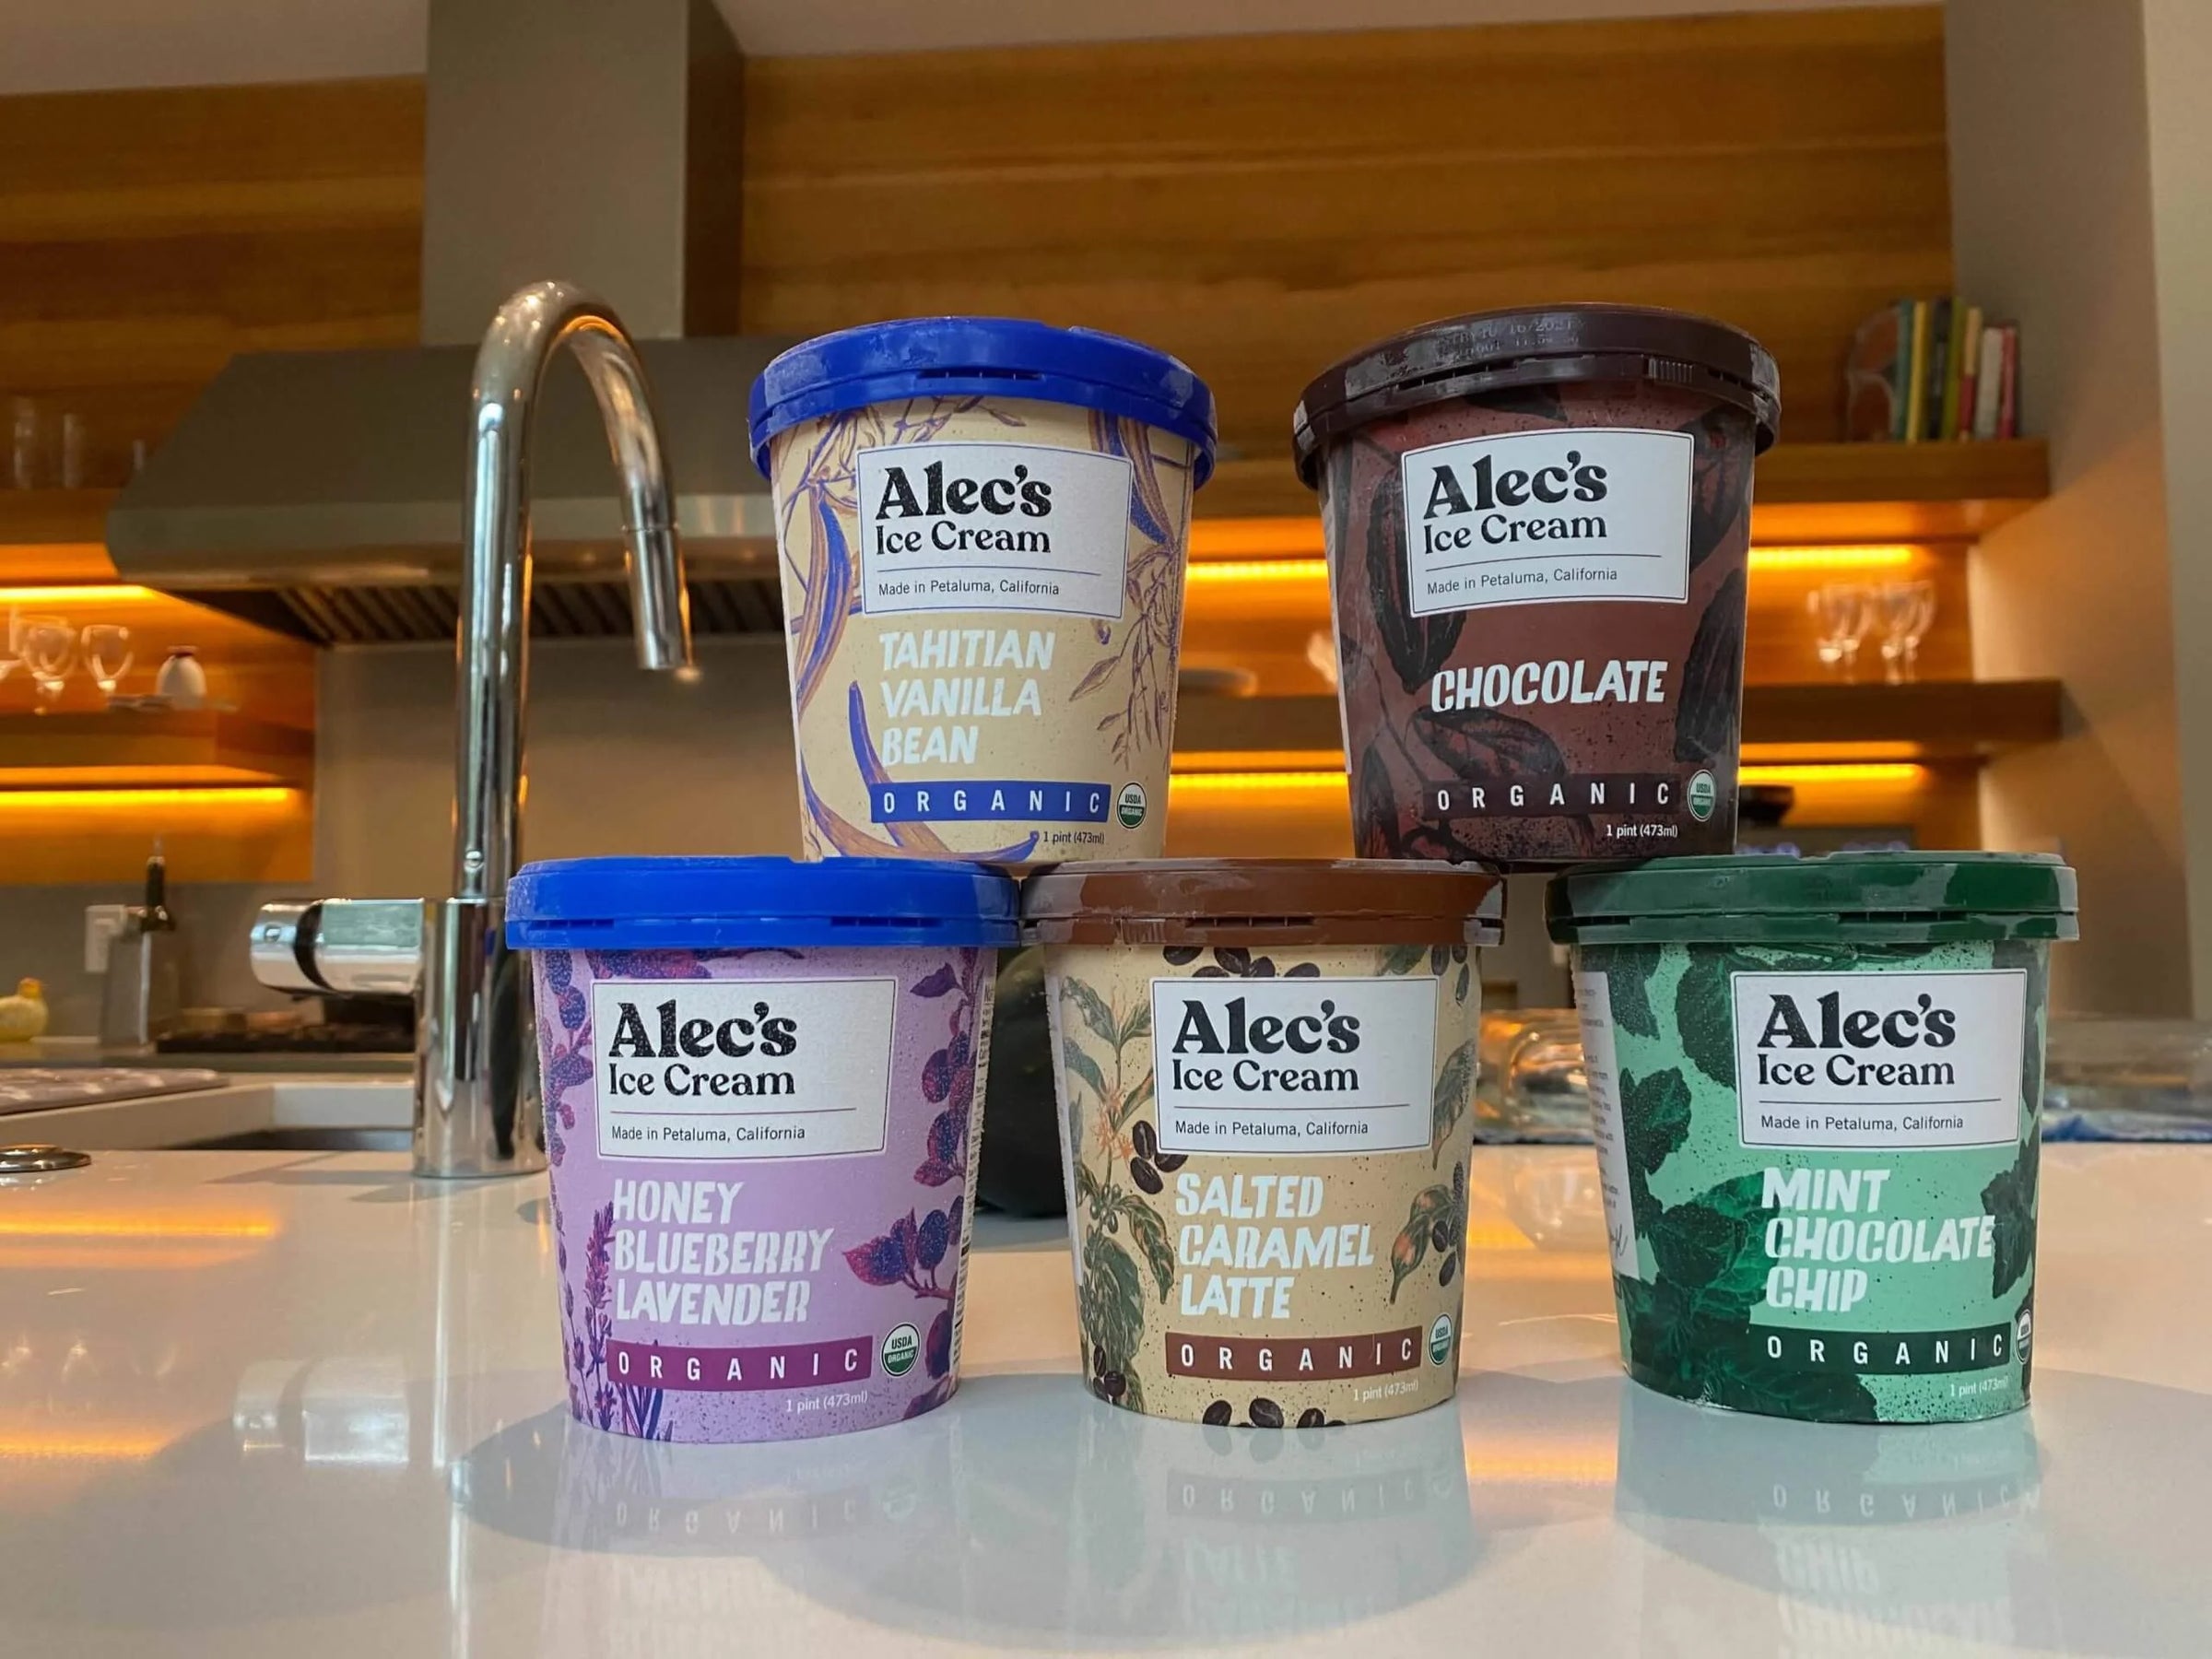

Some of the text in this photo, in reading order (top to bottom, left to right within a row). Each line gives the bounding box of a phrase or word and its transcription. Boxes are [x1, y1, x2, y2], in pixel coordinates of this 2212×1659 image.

[876, 462, 1052, 521] Alec's
[1423, 450, 1608, 520] Alec's
[877, 521, 1051, 555] Ice Cream
[1425, 512, 1607, 555] Ice Cream
[878, 579, 1059, 595] Made in Petaluma, California
[1427, 567, 1618, 594] Made in Petaluma, California
[879, 629, 1054, 670] TAHITIAN
[881, 677, 1041, 718] VANILLA
[1431, 660, 1668, 713] CHOCOLATE
[882, 726, 979, 766] BEAN
[884, 791, 1100, 814] ORGANIC
[1125, 794, 1141, 804] USDA
[1438, 782, 1670, 810] ORGANIC
[1043, 831, 1104, 844] 1 pint (473ml)
[1606, 824, 1677, 839] 1 pint (473ml)
[608, 998, 797, 1058] Alec's
[1172, 996, 1360, 1054] Alec's
[1758, 991, 1956, 1049] Alec's
[609, 1064, 795, 1096] Ice Cream
[1172, 1060, 1359, 1092] Ice Cream
[1759, 1053, 1955, 1087] Ice Cream
[611, 1125, 806, 1143] Made in Petaluma, California
[1175, 1121, 1368, 1137] Made in Petaluma, California
[1761, 1115, 1963, 1132] Made in Petaluma, California
[613, 1180, 745, 1223] HONEY
[1176, 1172, 1324, 1218] SALTED
[1760, 1168, 1890, 1212] MINT
[615, 1229, 834, 1276] BLUEBERRY
[1180, 1224, 1373, 1270] CARAMEL
[1765, 1215, 1995, 1265] CHOCOLATE
[616, 1279, 810, 1325] LAVENDER
[1180, 1276, 1294, 1319] LATTE
[1766, 1267, 1868, 1312] CHIP
[892, 1335, 912, 1349] USDA
[1182, 1338, 1411, 1371] ORGANIC
[1767, 1335, 2003, 1364] ORGANIC
[618, 1349, 857, 1380] ORGANIC
[785, 1391, 867, 1414] 1 pint (473ml)
[1354, 1389, 1359, 1400] 1
[1363, 1388, 1382, 1403] pint
[1959, 1382, 1976, 1397] pint
